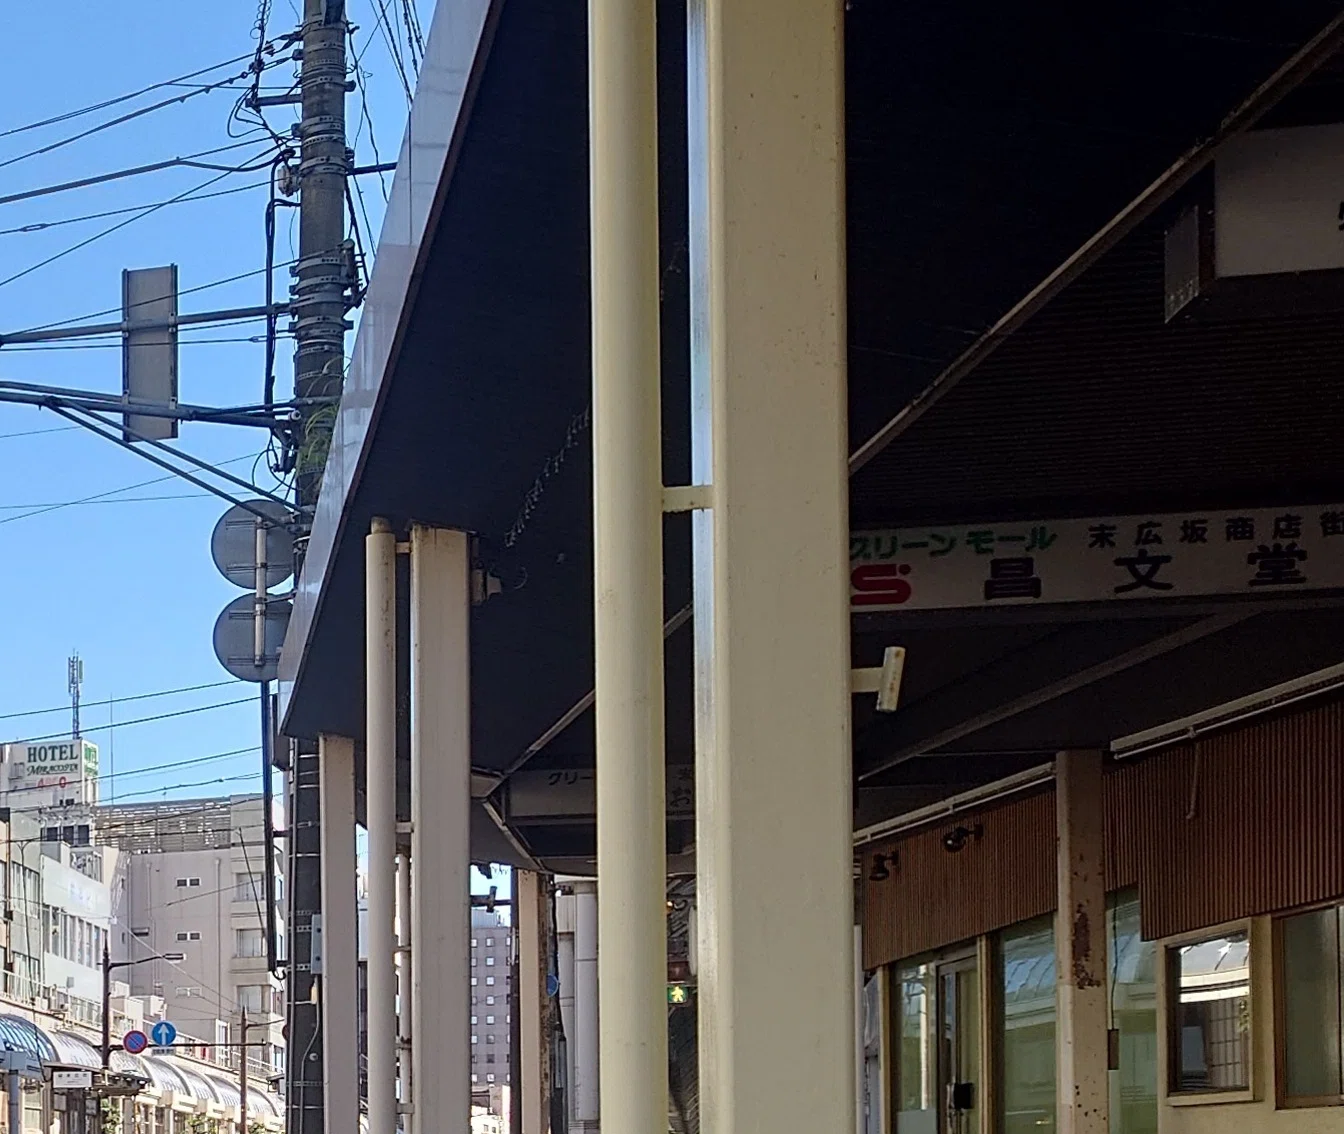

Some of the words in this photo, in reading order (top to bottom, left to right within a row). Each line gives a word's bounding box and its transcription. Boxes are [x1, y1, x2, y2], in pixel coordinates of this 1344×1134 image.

[849, 526, 1058, 561] グリーンモール
[1087, 511, 1344, 549] 末広坂商店街
[984, 542, 1308, 600] 昌文堂
[27, 744, 79, 763] HOTEL
[548, 772, 596, 786] グリー
